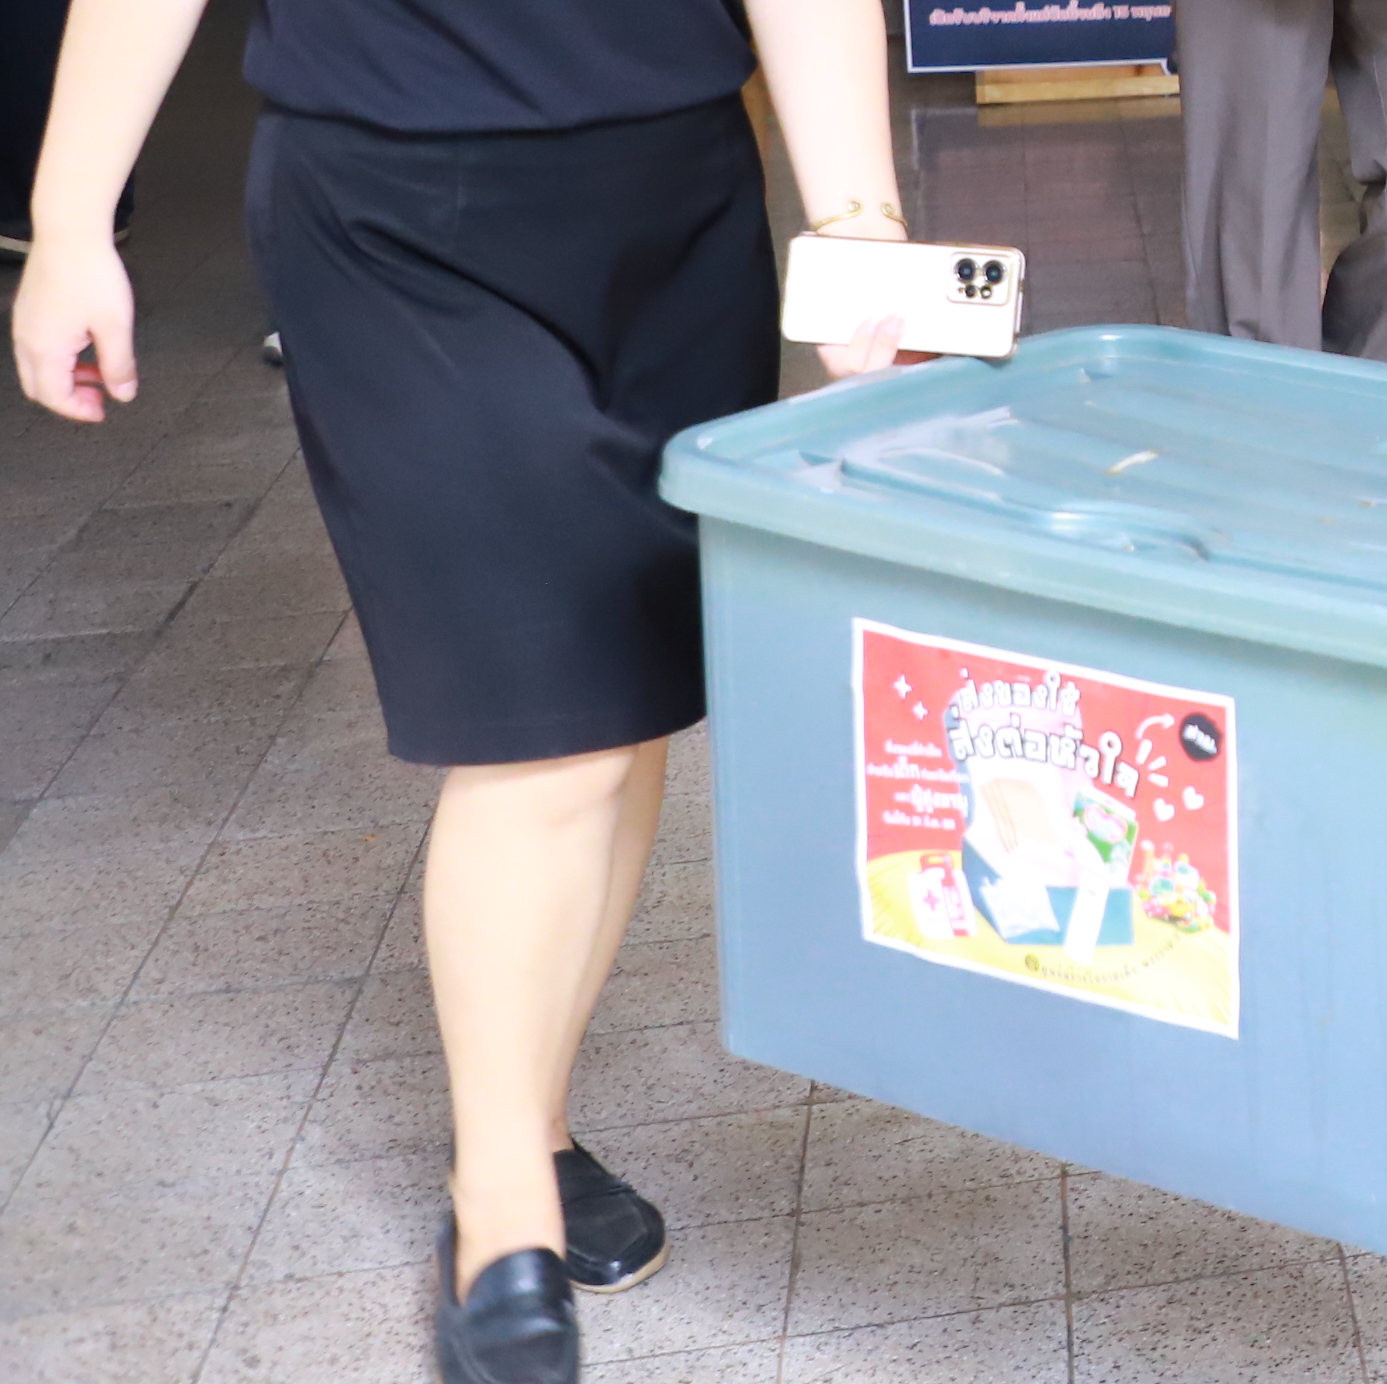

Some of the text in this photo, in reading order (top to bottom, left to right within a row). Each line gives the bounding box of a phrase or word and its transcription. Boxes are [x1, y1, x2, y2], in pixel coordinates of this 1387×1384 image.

[959, 667, 1082, 717] ส่งของใช้
[946, 705, 1141, 799] ส่งต่อหัวใจ
